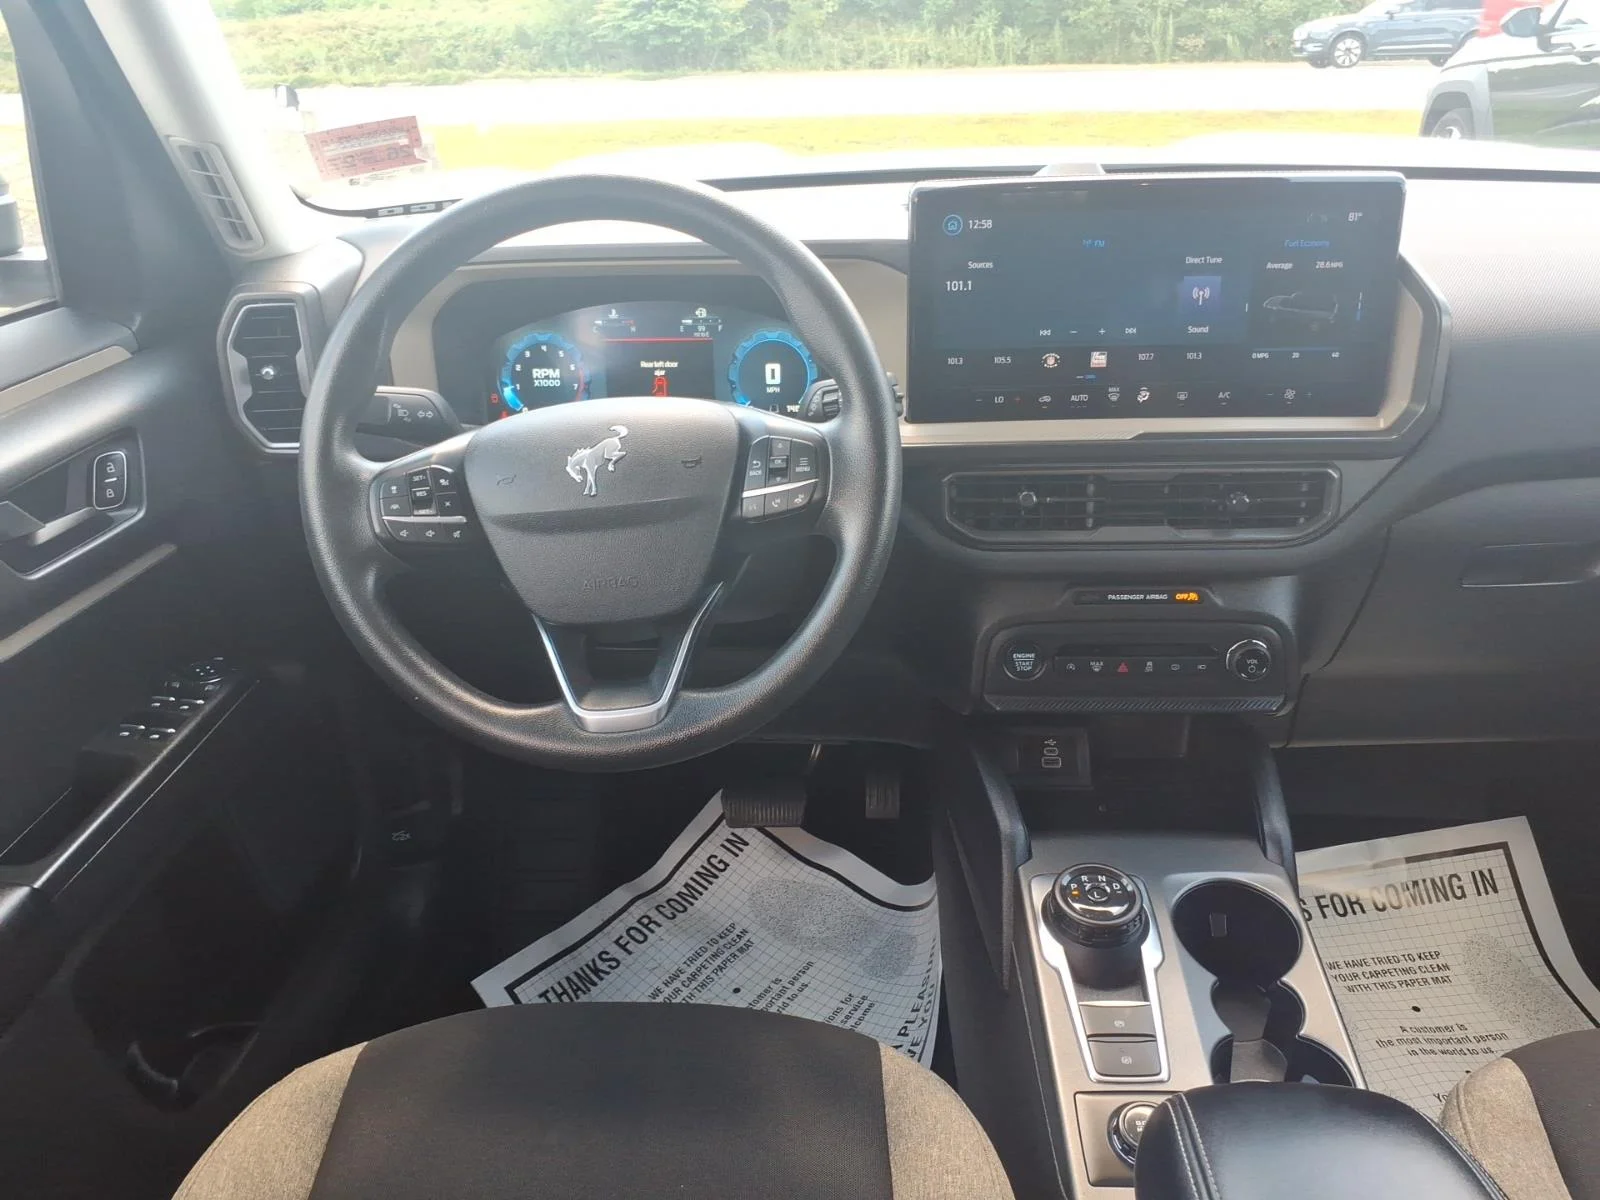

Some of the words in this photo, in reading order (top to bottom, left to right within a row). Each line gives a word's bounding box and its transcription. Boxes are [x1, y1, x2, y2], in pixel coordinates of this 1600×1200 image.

[968, 219, 993, 229] 12:58
[967, 261, 993, 270] Sources
[1185, 256, 1205, 265] Direct
[1206, 256, 1223, 264] Tune
[1266, 262, 1293, 271] Average
[946, 280, 972, 291] 101.1
[1187, 325, 1209, 334] Sound
[640, 360, 654, 368] Rear
[664, 360, 679, 368] door
[532, 368, 560, 379] RPM
[764, 363, 781, 385] 0
[1070, 394, 1089, 402] AUTO
[1218, 391, 1231, 399] A/C
[1112, 882, 1120, 890] D
[1315, 892, 1367, 920] FOR
[1370, 873, 1468, 913] COMING
[1470, 868, 1500, 898] IN
[538, 950, 621, 1003] THANKS
[613, 914, 662, 956] FOR
[655, 853, 730, 920] COMING
[720, 832, 749, 858] IN
[648, 985, 665, 1000] WE
[662, 966, 687, 988] HAVE
[682, 945, 709, 968] TRIED
[706, 937, 720, 948] TO
[717, 922, 736, 940] KEEP
[662, 986, 684, 1004] OUR
[680, 947, 726, 989] CARPETING
[722, 928, 749, 950] CLEAN
[693, 974, 716, 995] THIS
[711, 951, 739, 977] PAPER
[737, 937, 755, 956] MAT
[1326, 960, 1345, 971] WE
[1343, 957, 1371, 969] HAVE
[1370, 955, 1401, 967] TRIED
[1401, 953, 1416, 963] TO
[1416, 950, 1441, 961] KEEP
[787, 960, 815, 987] person
[1331, 971, 1361, 983] YOUR
[1361, 966, 1418, 980] CARPETING
[1418, 962, 1451, 974] CLEAN
[1344, 982, 1372, 993] WITH
[1372, 980, 1398, 992] THIS
[1397, 977, 1431, 989] PAPER
[1430, 975, 1453, 985] MAT
[786, 992, 798, 1002] to
[840, 994, 868, 1025] service
[1399, 1025, 1407, 1033] A
[1409, 1024, 1456, 1034] customer
[1456, 1022, 1468, 1031] is
[1376, 1038, 1395, 1049] the
[1396, 1035, 1423, 1046] most
[1423, 1034, 1472, 1046] important
[1472, 1031, 1509, 1044] person
[1407, 1047, 1419, 1057] in
[1419, 1046, 1438, 1056] the
[1437, 1047, 1467, 1056] world
[1467, 1046, 1480, 1056] to
